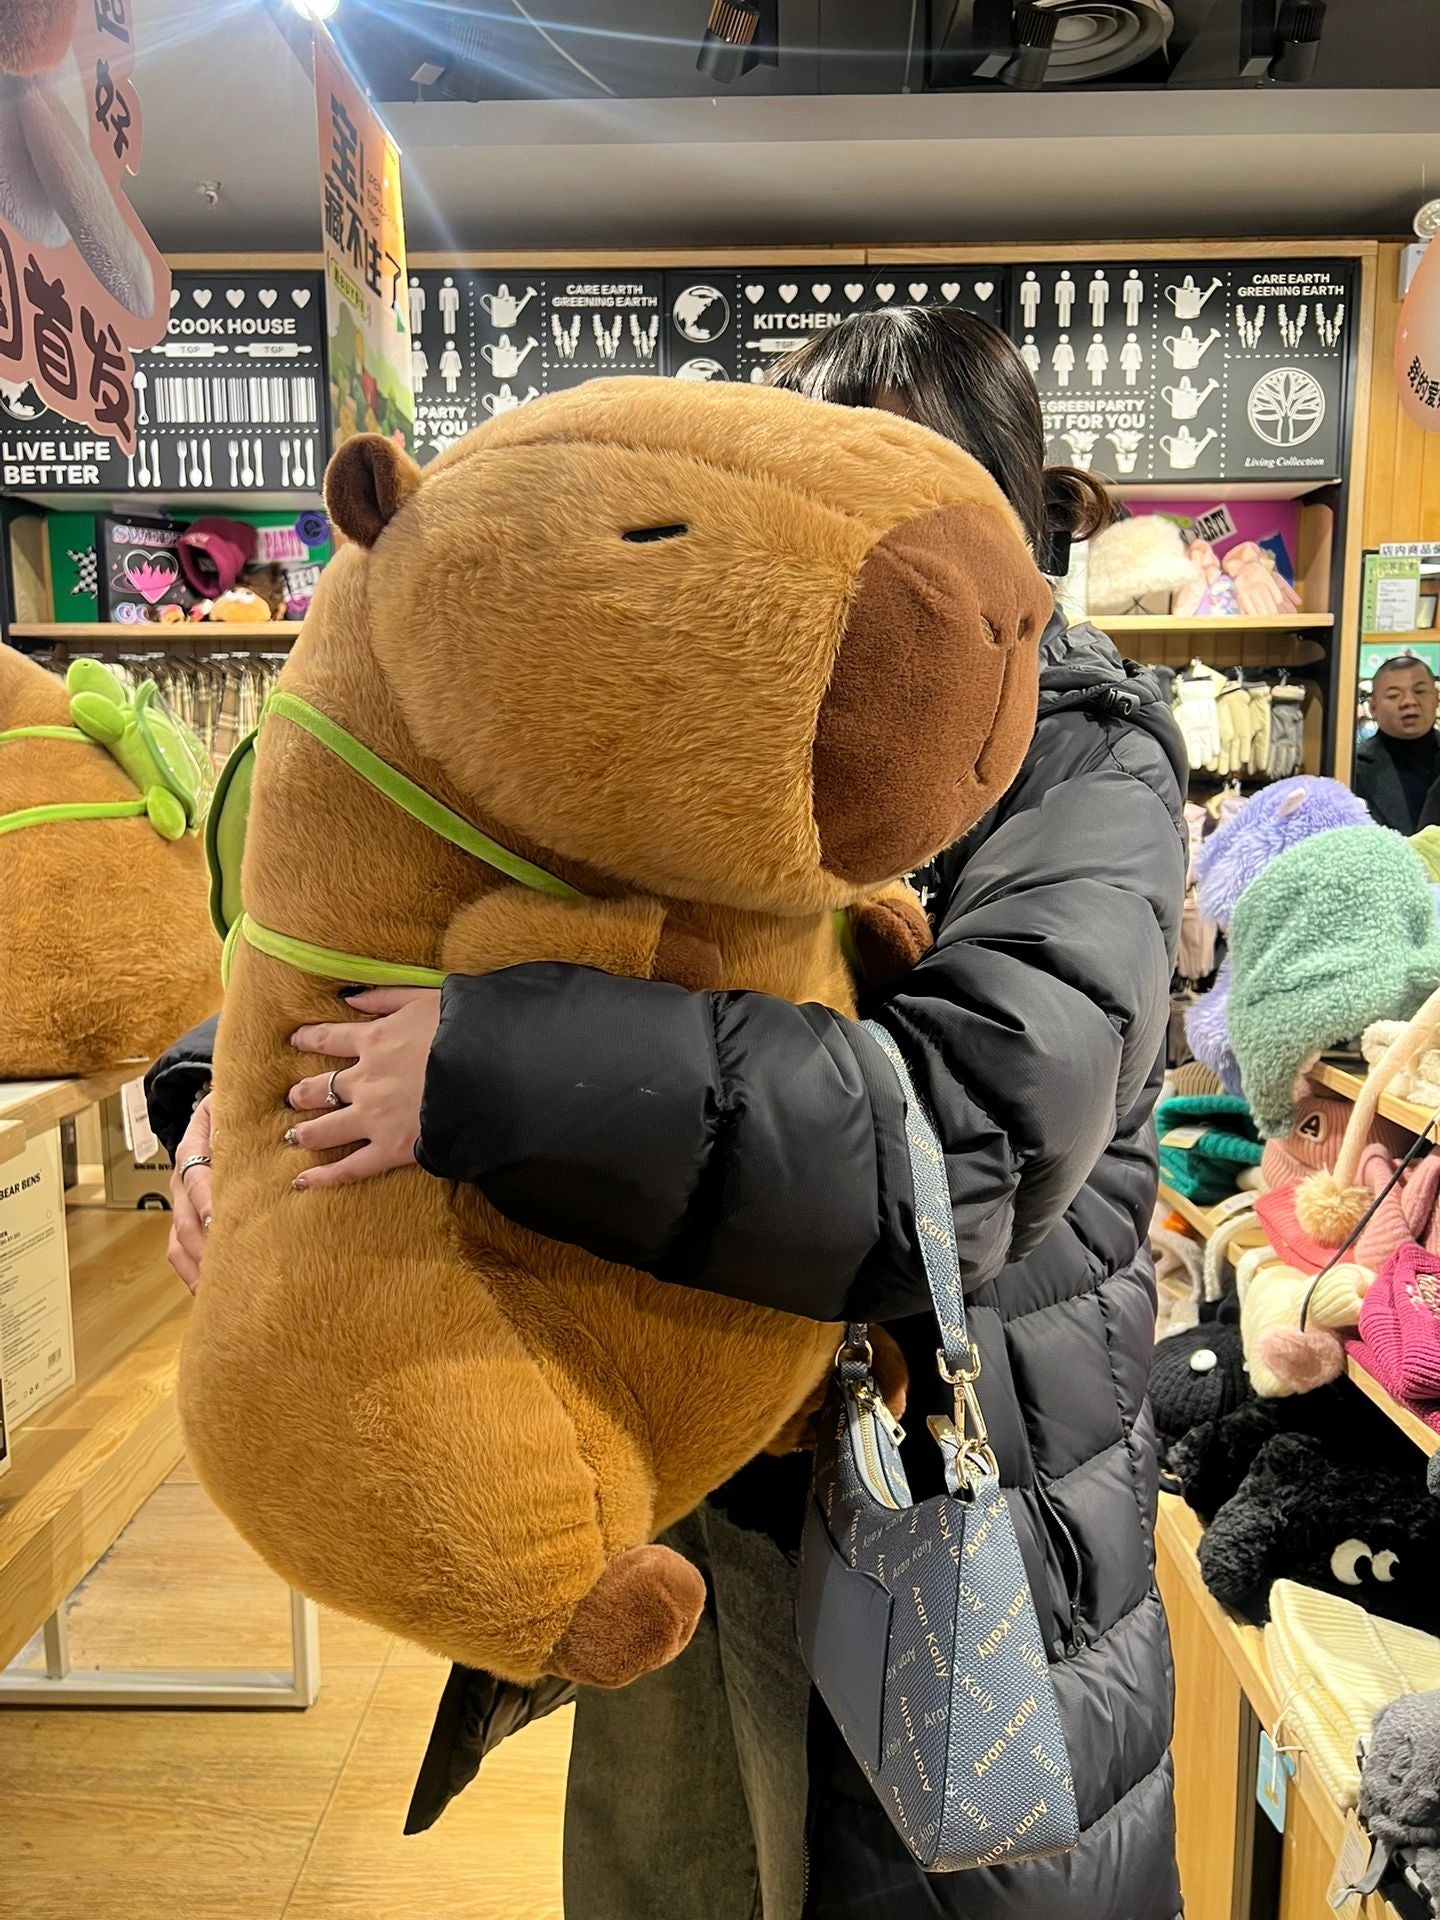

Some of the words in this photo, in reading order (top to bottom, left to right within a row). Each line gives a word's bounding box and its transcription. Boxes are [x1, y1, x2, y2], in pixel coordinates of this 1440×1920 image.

[1252, 273, 1286, 285] CARE
[1288, 273, 1330, 284] EARTH
[566, 284, 599, 295] CARE
[601, 284, 643, 295] EARTH
[1237, 285, 1300, 297] GREENING
[1302, 285, 1344, 296] EARTH
[551, 296, 614, 308] GREENING
[616, 296, 658, 308] EARTH
[167, 318, 224, 336] COOK
[227, 318, 296, 335] HOUSE
[753, 313, 842, 331] KITCHEN
[418, 405, 467, 420] PARTY
[1047, 400, 1095, 412] GREEN
[1096, 400, 1145, 412] PARTY
[429, 420, 468, 437] YOU
[1066, 414, 1103, 429] FOR
[1105, 413, 1145, 429] YOU
[2, 441, 56, 461] LIVE
[59, 441, 111, 461] LIFE
[1276, 456, 1325, 467] Collection
[4, 464, 100, 485] BETTER
[1300, 1115, 1320, 1138] A
[0, 1182, 20, 1201] BEAR
[21, 1172, 41, 1190] BENS
[912, 1586, 929, 1627] Aran
[925, 1631, 949, 1678] Kally
[960, 1673, 998, 1714] Kally
[900, 1696, 916, 1742] Kally
[913, 1749, 933, 1793] Aran
[973, 1737, 1008, 1778] Aran
[1003, 1694, 1039, 1738] Kally
[1030, 1744, 1062, 1778] Aran
[1014, 1798, 1049, 1835] Aran
[976, 1835, 1017, 1866] Kally
